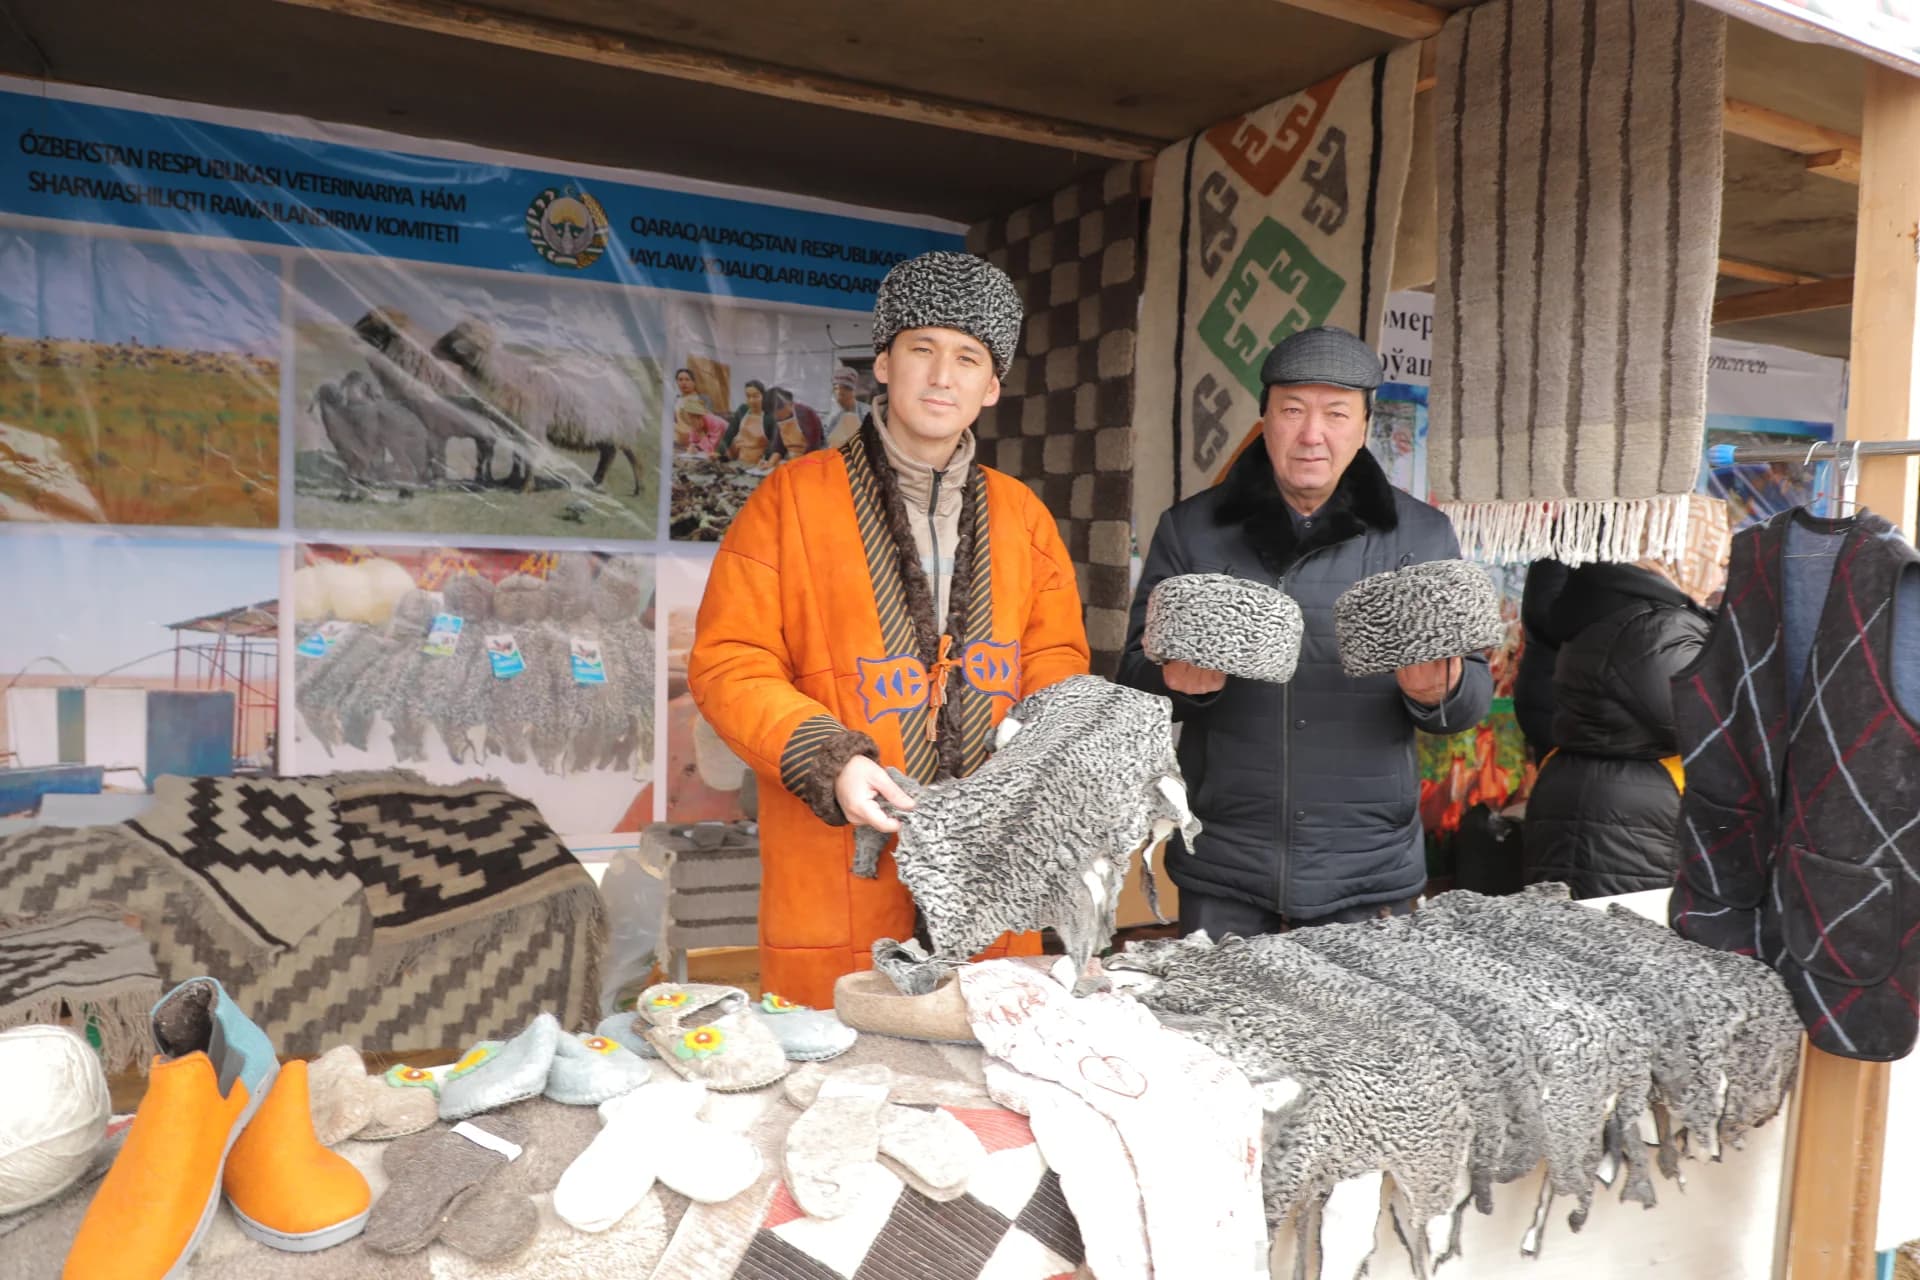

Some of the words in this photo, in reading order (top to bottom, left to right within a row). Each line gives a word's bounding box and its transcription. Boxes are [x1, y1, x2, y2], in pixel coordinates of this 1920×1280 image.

[19, 128, 143, 168] ÓZBEKSTAN
[147, 150, 281, 186] RESPUBLIKASI
[285, 170, 415, 206] VETERINARIYA
[420, 186, 467, 213] HÁM
[28, 170, 206, 213] SHARWASHILIQTI
[375, 215, 459, 243] KOMITETI
[631, 215, 797, 254] QARAQALPAQSTAN
